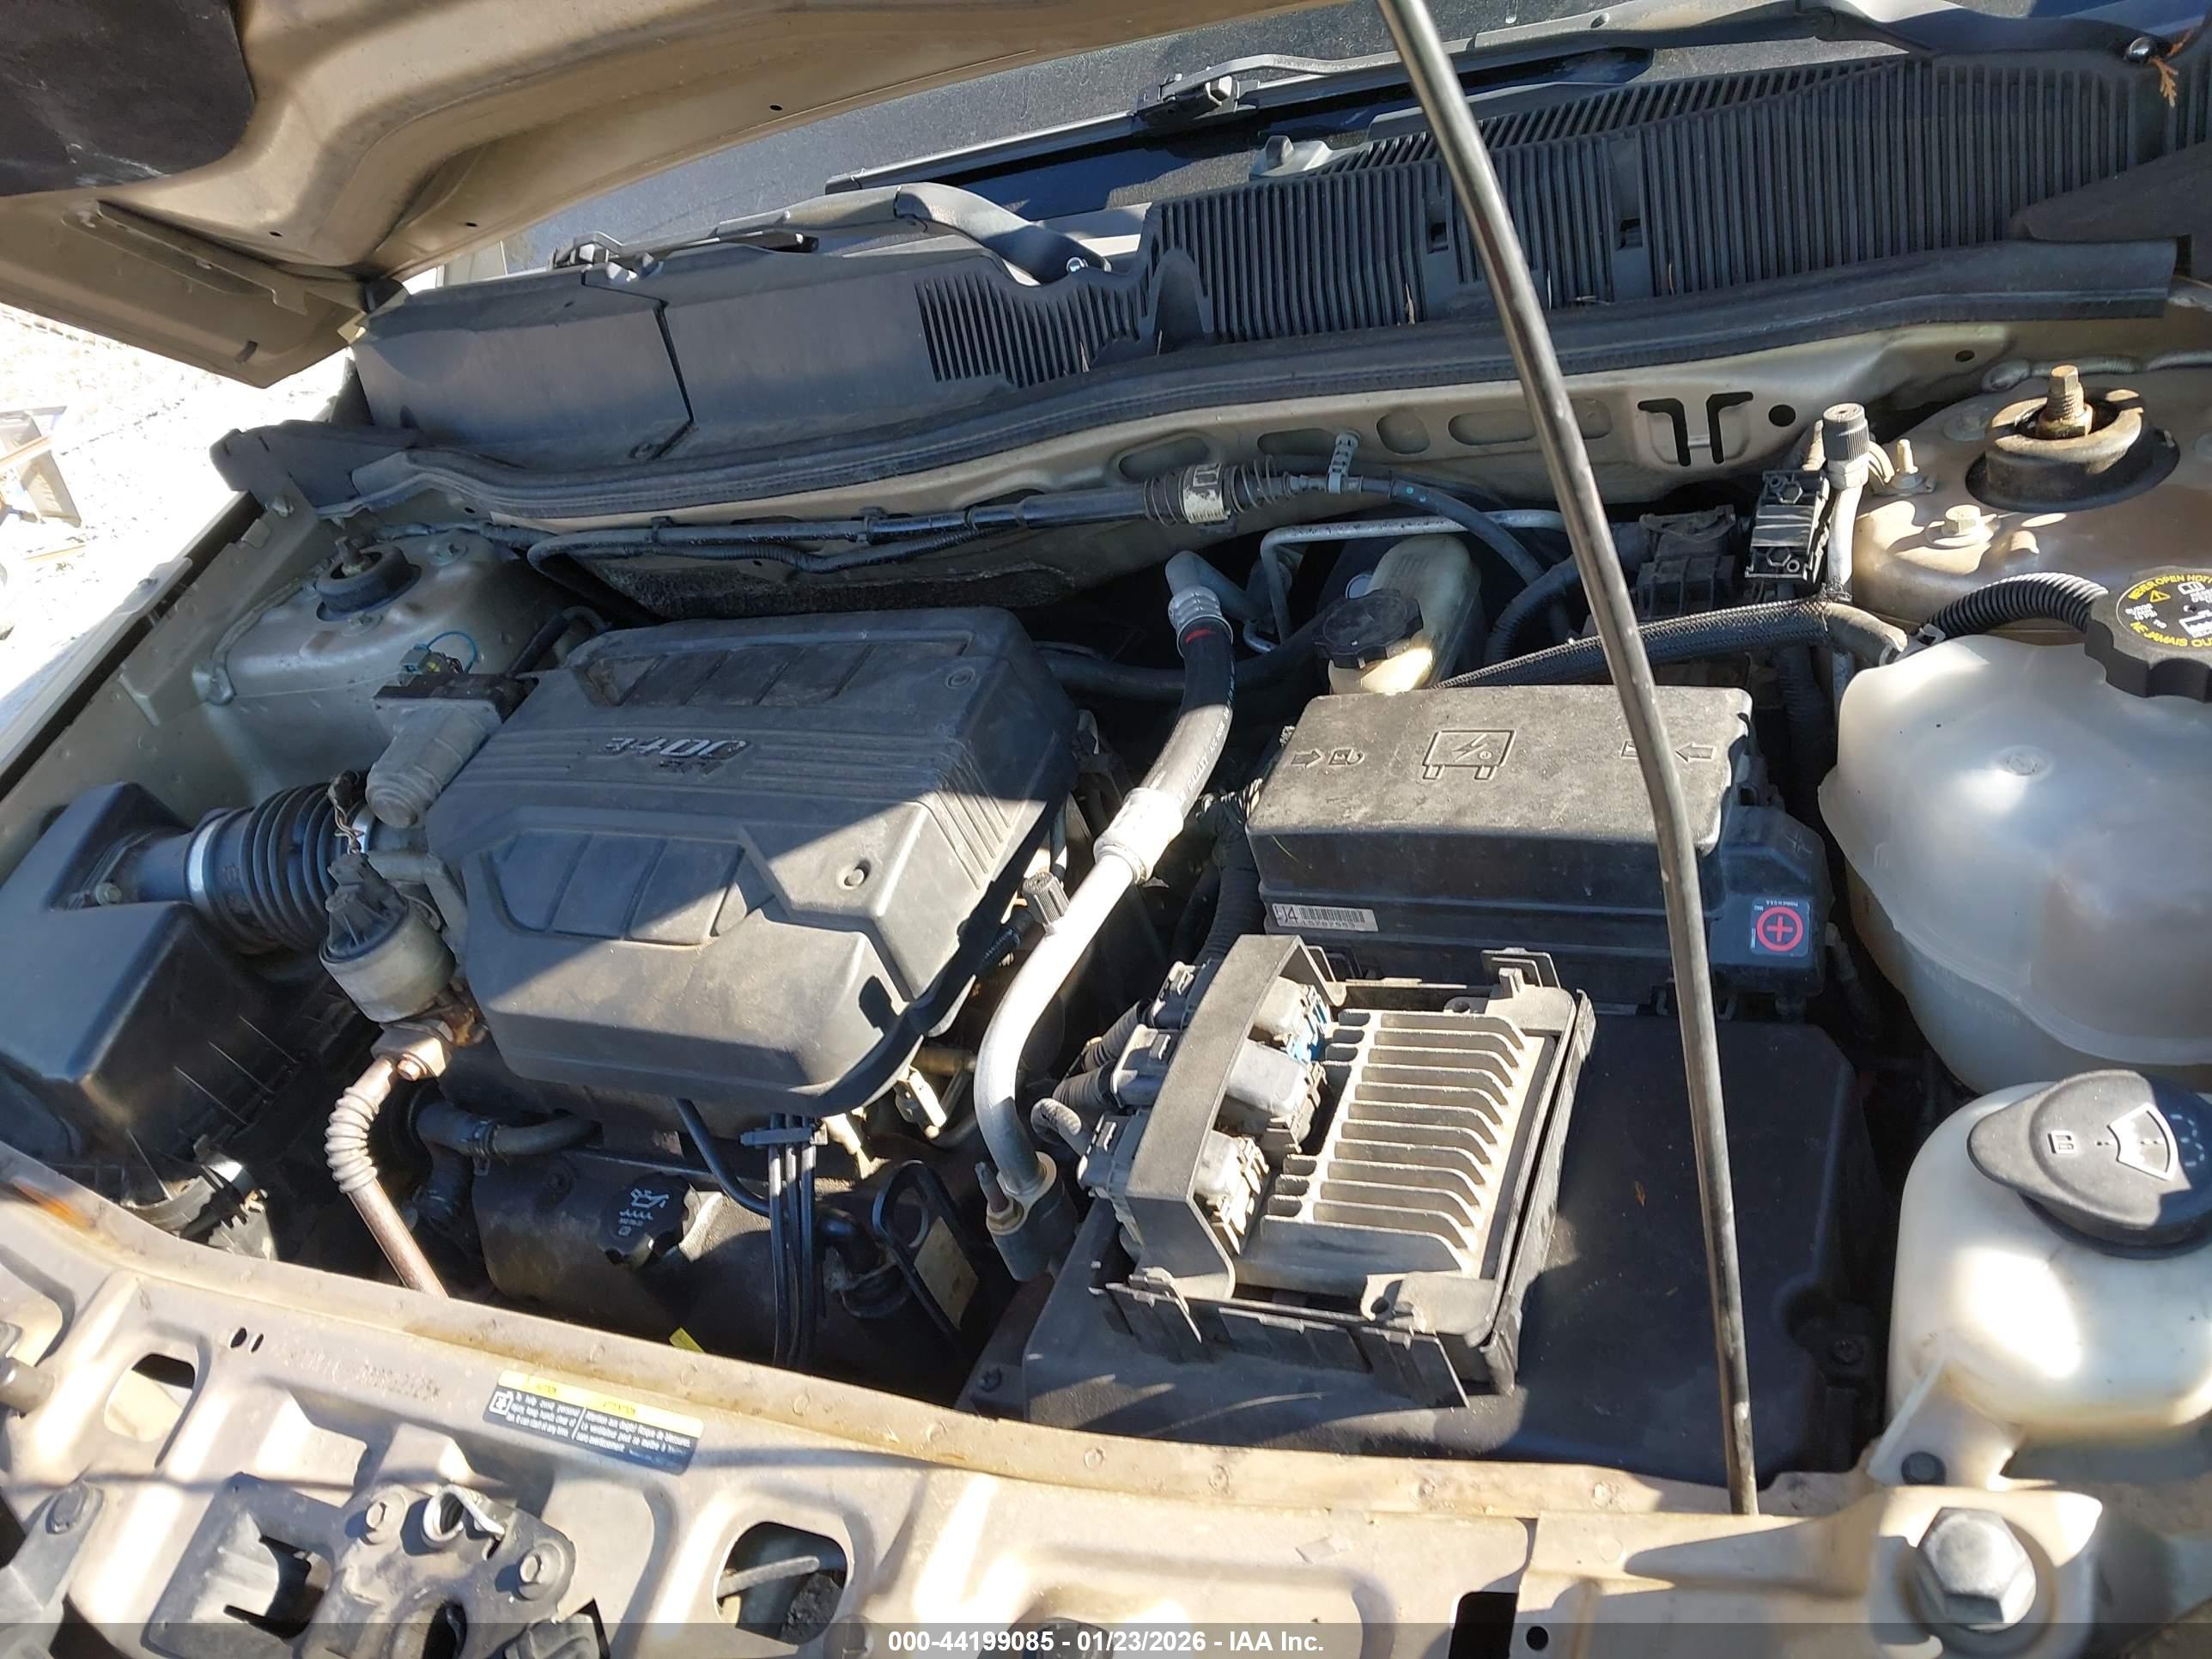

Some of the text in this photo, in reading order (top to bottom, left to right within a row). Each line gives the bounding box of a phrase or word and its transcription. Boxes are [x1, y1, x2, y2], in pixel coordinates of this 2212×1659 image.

[2155, 574, 2185, 585] OPEN
[2130, 622, 2148, 634] NE
[2143, 631, 2188, 647] JAMAIS
[2191, 637, 2212, 647] OU
